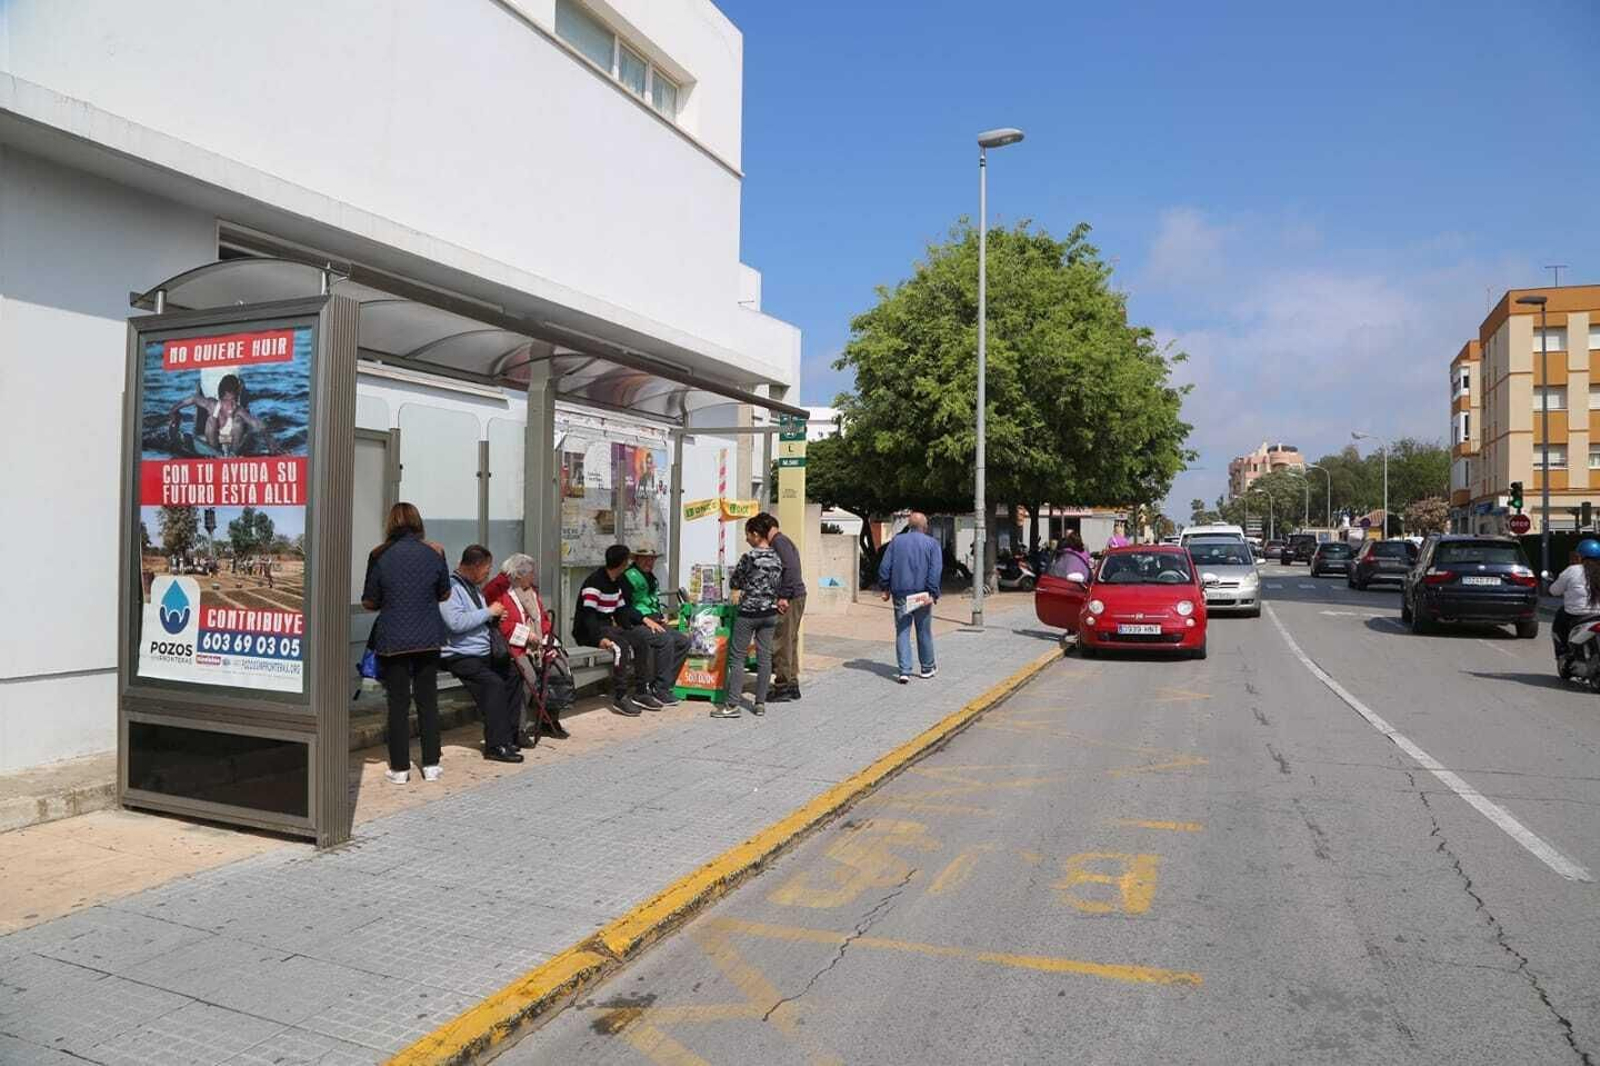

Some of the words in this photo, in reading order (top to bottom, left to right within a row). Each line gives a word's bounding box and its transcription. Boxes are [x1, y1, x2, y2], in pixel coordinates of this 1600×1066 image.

[169, 346, 187, 364] NO
[193, 341, 244, 361] QUIERE
[252, 337, 287, 356] HUIR
[163, 464, 189, 484] CON
[197, 463, 213, 483] TU
[222, 462, 268, 483] AYUDA
[278, 461, 297, 482] SU
[163, 484, 214, 504] FUTURO
[222, 484, 257, 504] ESTA
[265, 483, 297, 504] ALLI
[207, 608, 303, 634] CONTRIBUYE
[150, 641, 193, 657] POZOS
[202, 632, 230, 650] 603
[234, 635, 252, 653] 69
[256, 636, 275, 655] 03
[280, 638, 300, 657] 05
